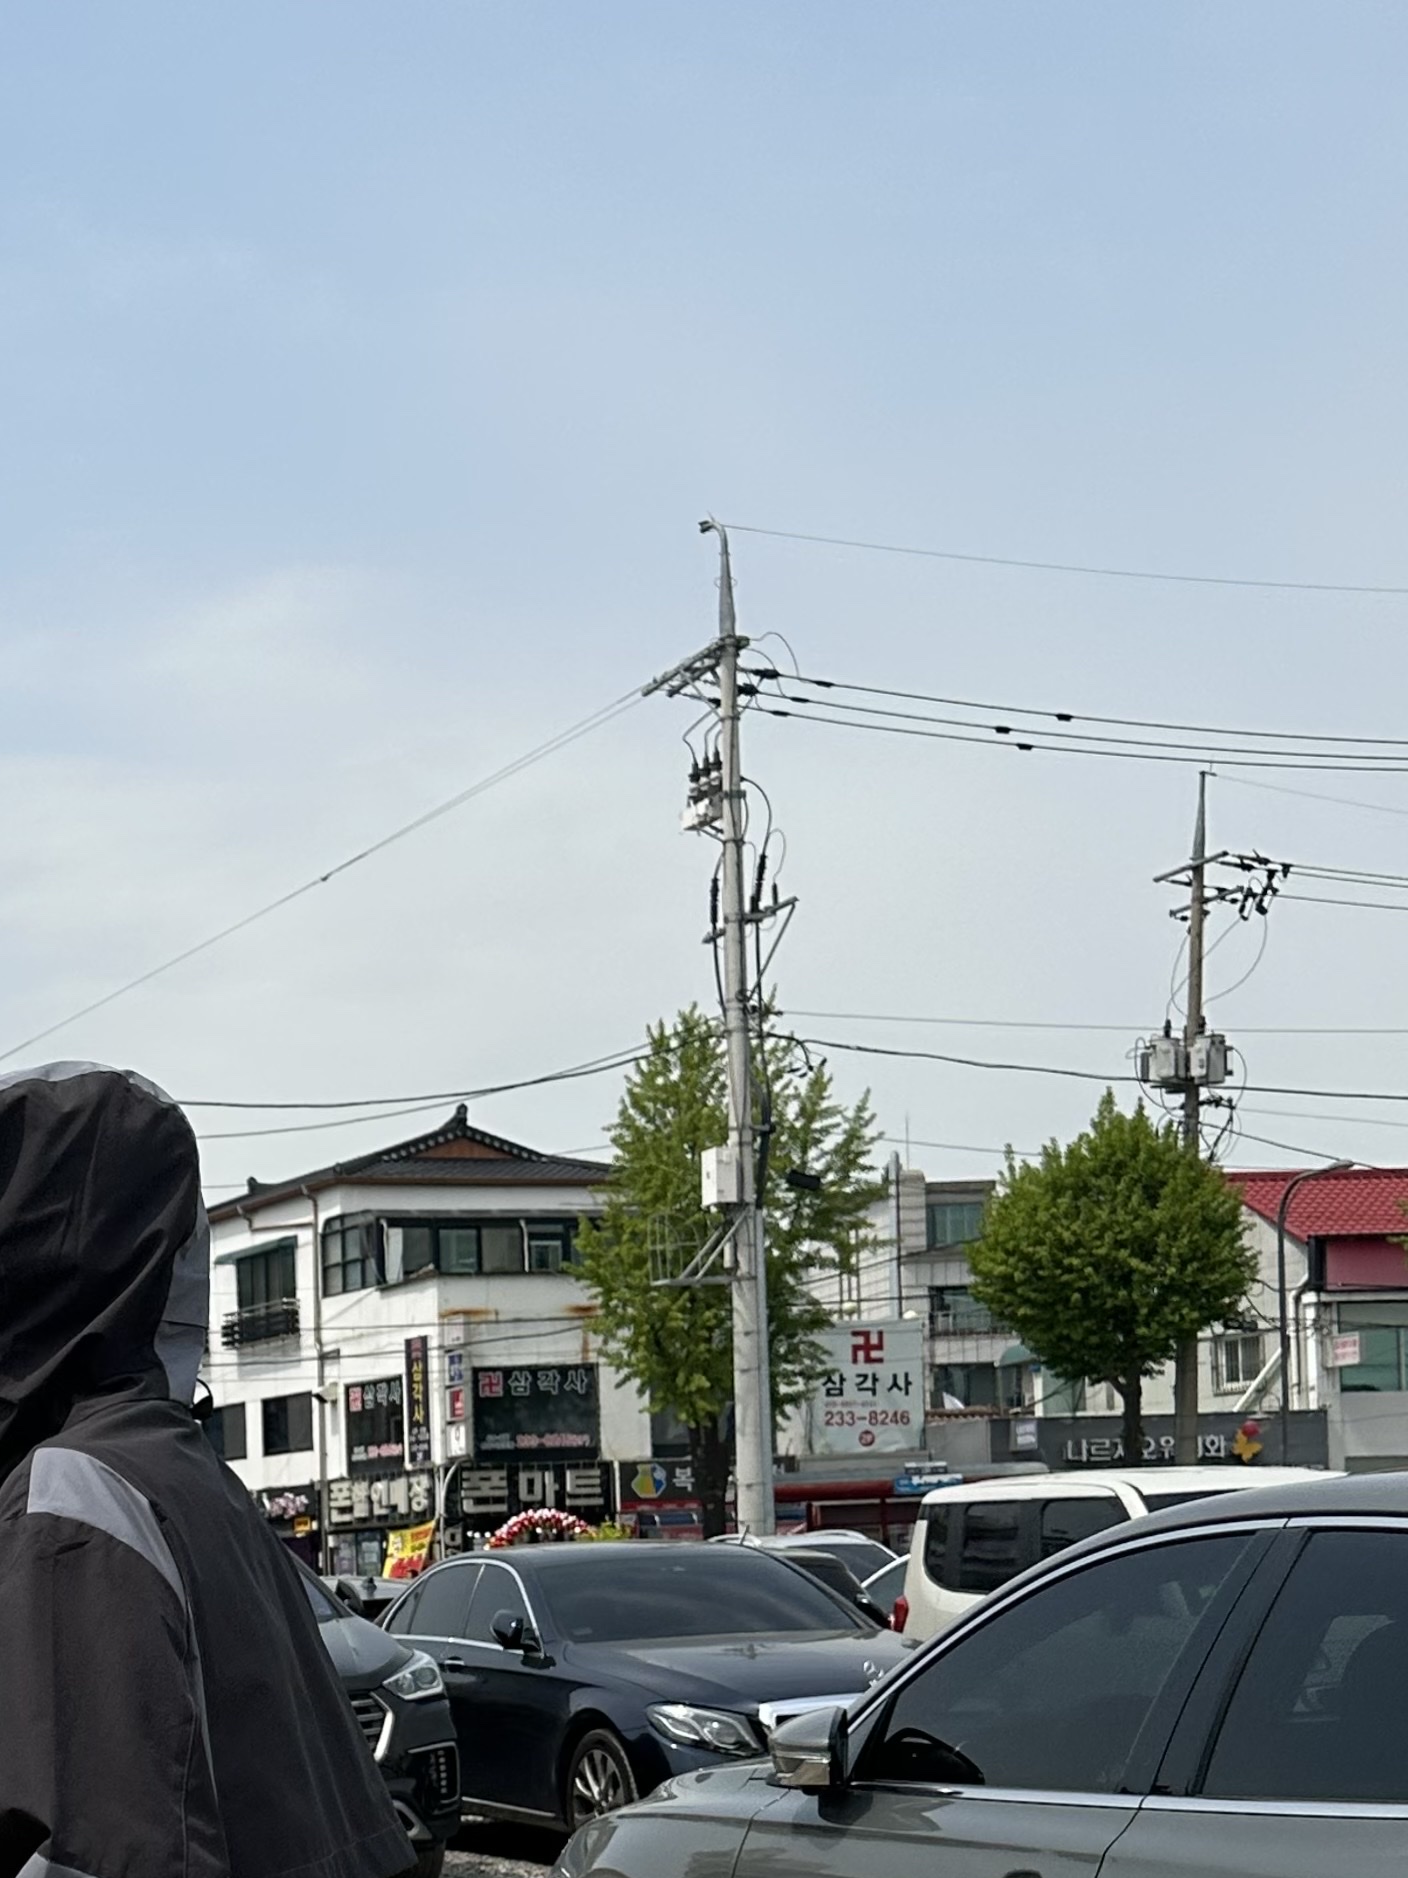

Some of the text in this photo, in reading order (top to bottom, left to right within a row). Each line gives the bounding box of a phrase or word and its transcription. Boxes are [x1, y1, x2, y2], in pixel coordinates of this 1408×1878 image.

[363, 1379, 402, 1410] 삼각사
[411, 1360, 424, 1424] 삼각사
[508, 1369, 588, 1396] 삼각사
[822, 1371, 913, 1398] 삼각사
[824, 1410, 911, 1427] 233-8246
[461, 1468, 605, 1515] 폰마트
